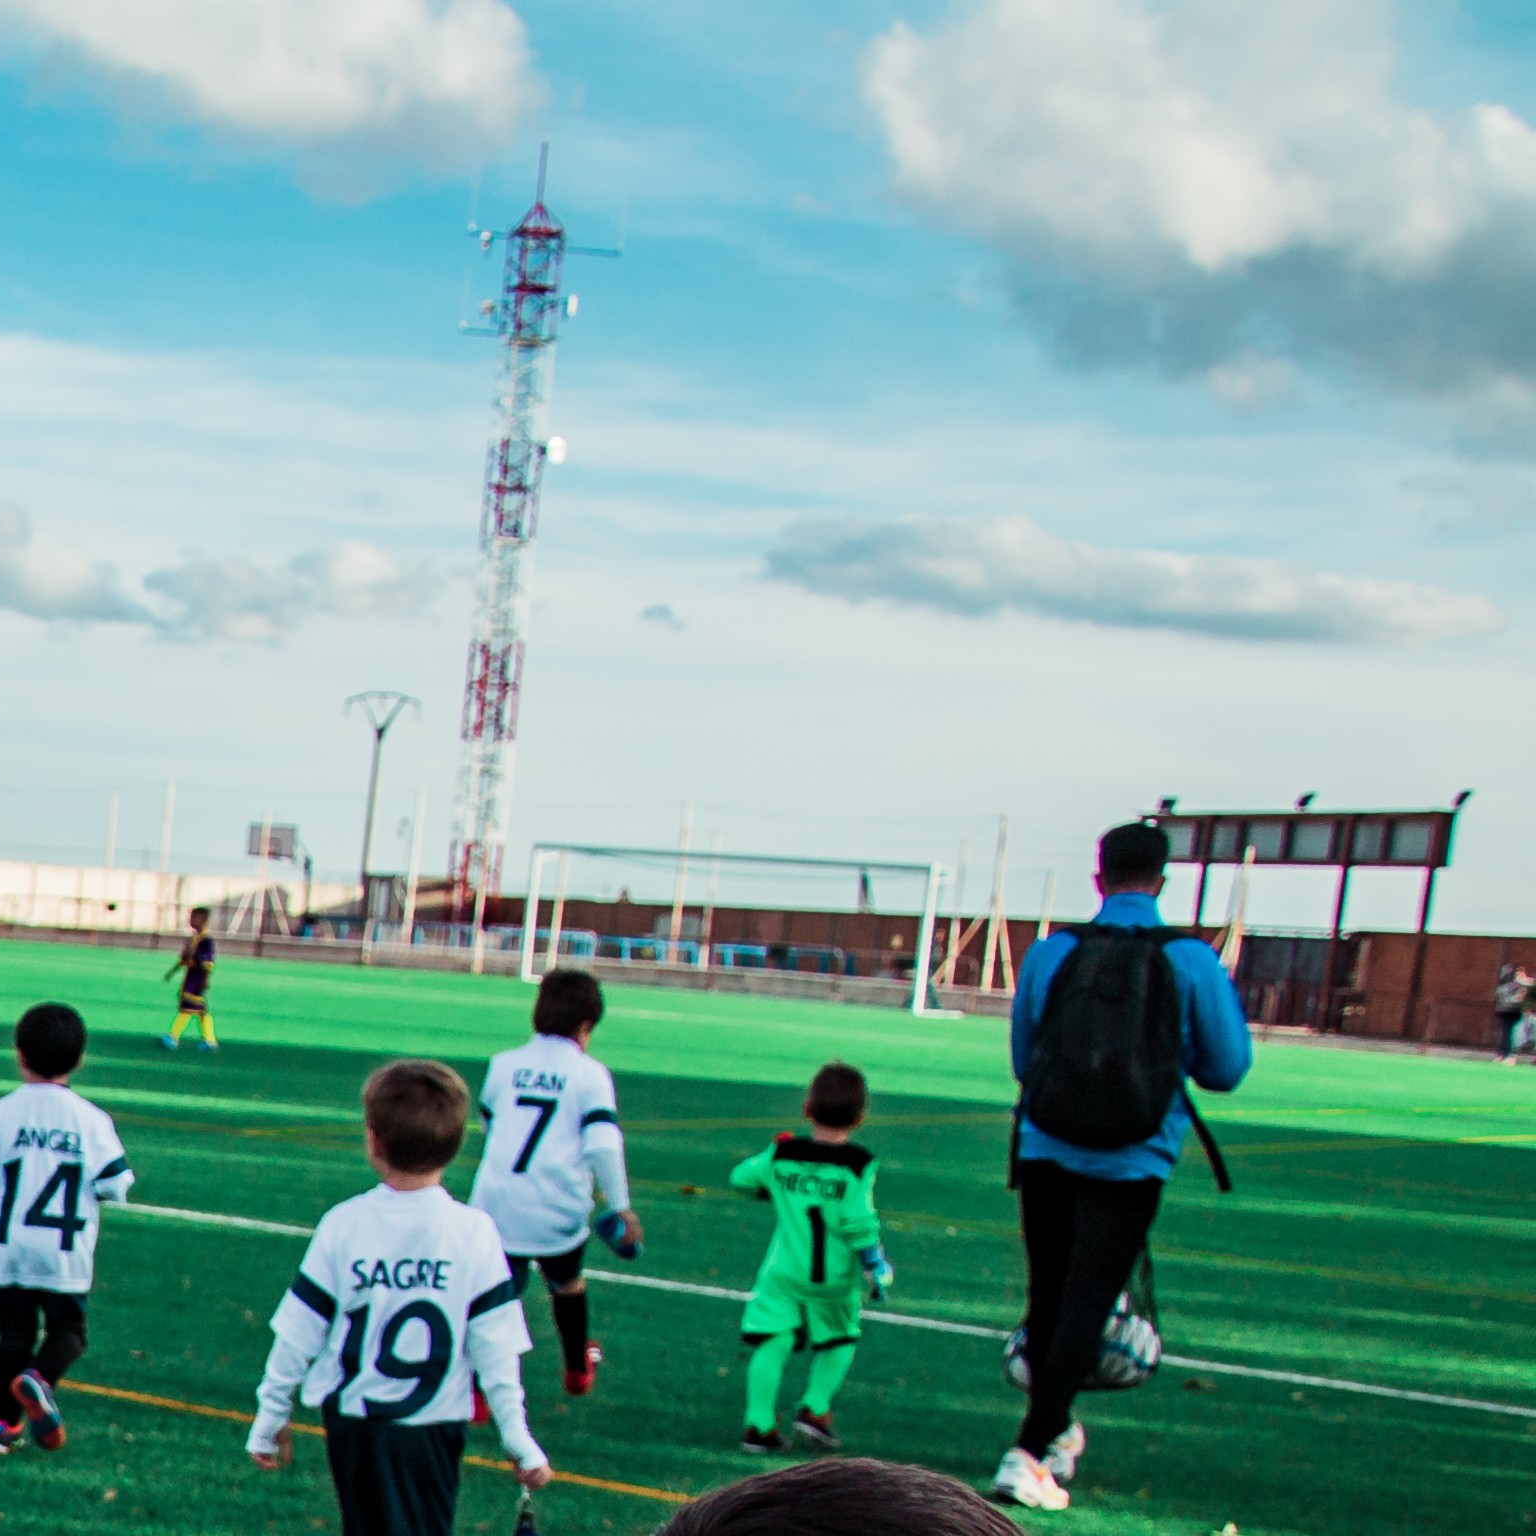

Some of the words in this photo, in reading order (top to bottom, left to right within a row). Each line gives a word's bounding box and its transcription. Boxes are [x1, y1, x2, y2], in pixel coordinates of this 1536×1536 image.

[512, 1095, 559, 1173] 7
[350, 1258, 452, 1291] SAGRE
[807, 1205, 826, 1284] 1
[334, 1299, 455, 1421] 19
